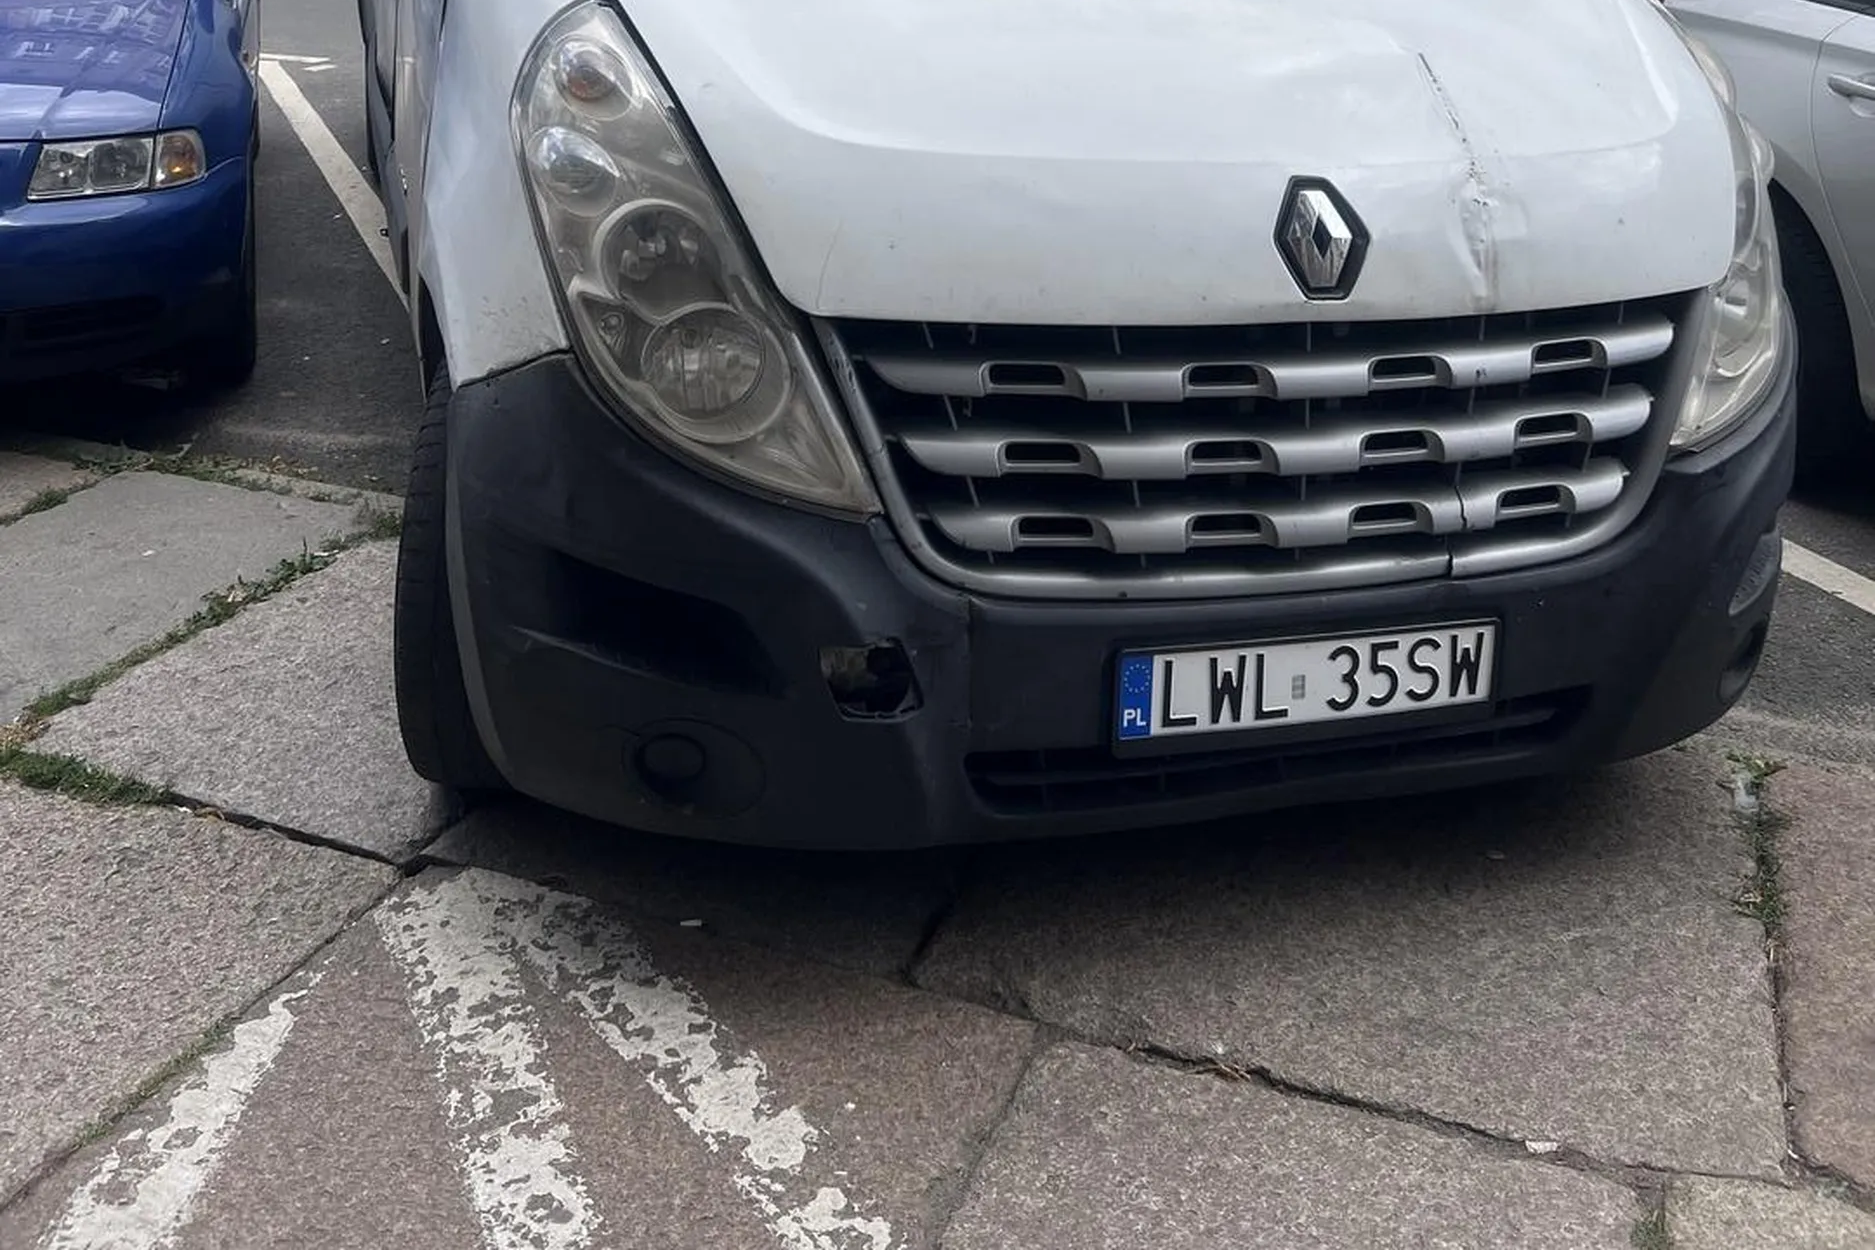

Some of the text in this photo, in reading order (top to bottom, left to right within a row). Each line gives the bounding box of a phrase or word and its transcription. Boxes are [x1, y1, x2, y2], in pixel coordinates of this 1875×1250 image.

[1161, 631, 1486, 728] LWL 35SW
[1123, 708, 1147, 728] PL
